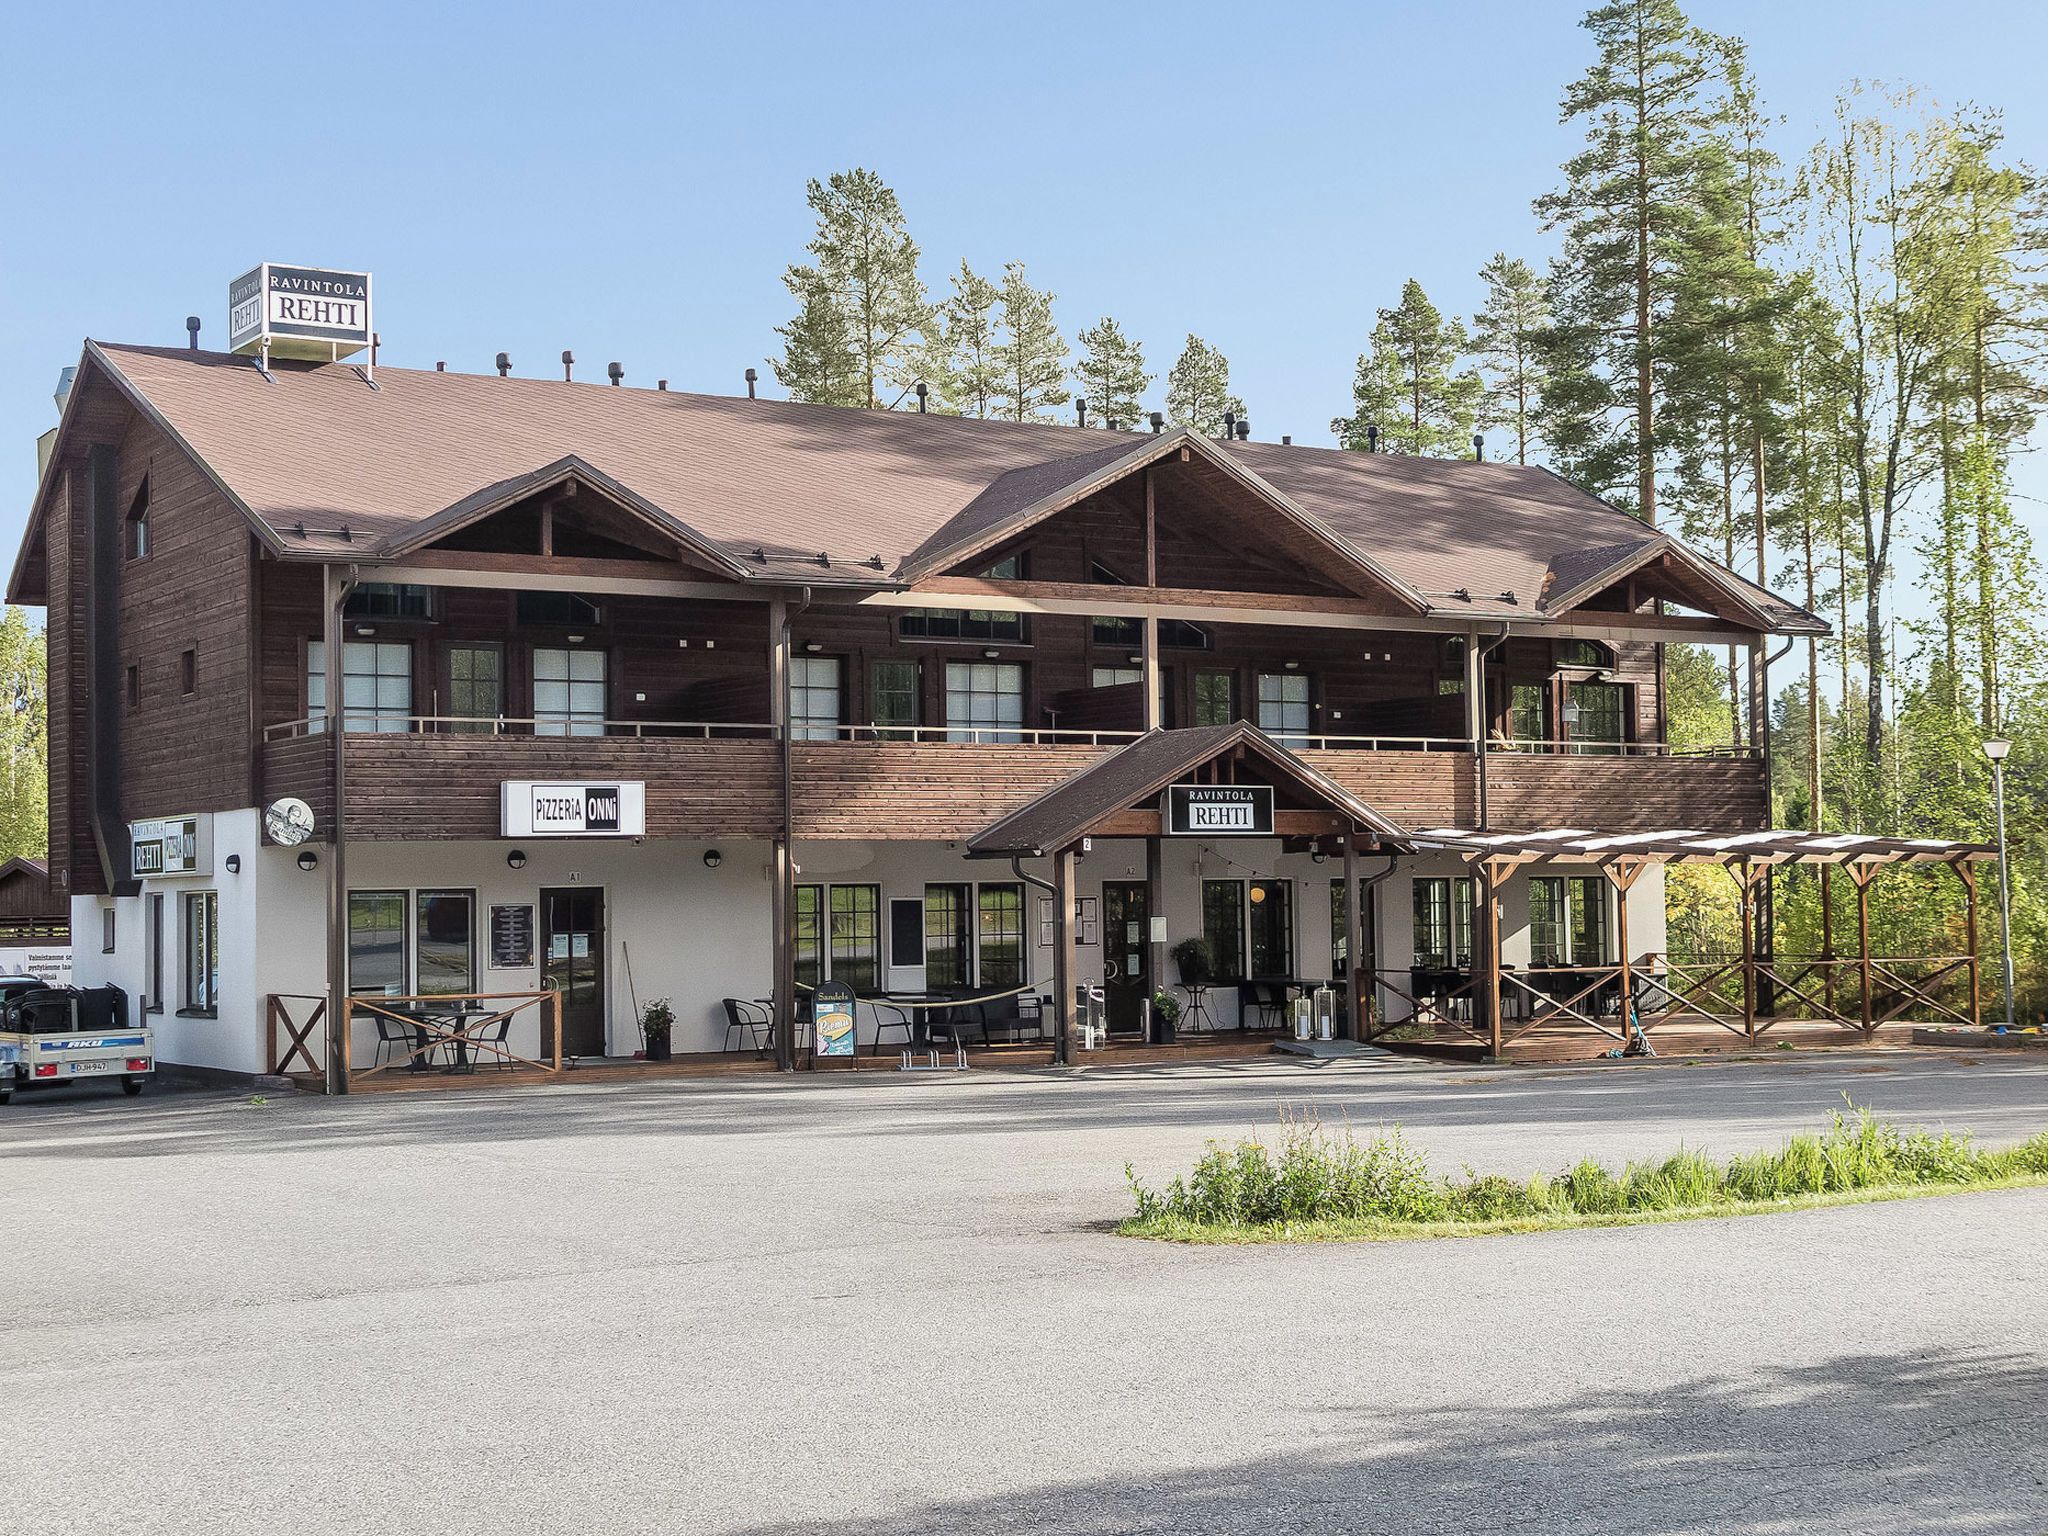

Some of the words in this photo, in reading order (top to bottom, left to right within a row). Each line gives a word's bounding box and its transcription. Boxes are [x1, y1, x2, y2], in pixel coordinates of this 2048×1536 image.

[269, 275, 366, 297] RAVINTOLA
[234, 299, 260, 333] REHTI
[279, 296, 357, 326] REHTI
[1189, 790, 1254, 801] RAVINTOLA
[1195, 807, 1249, 825] REHTI
[1084, 840, 1090, 849] 2
[136, 845, 161, 870] REHTI
[570, 873, 580, 882] A1
[1126, 868, 1136, 876] A2
[818, 991, 848, 1001] Sandels
[76, 1062, 106, 1072] DJH-947
